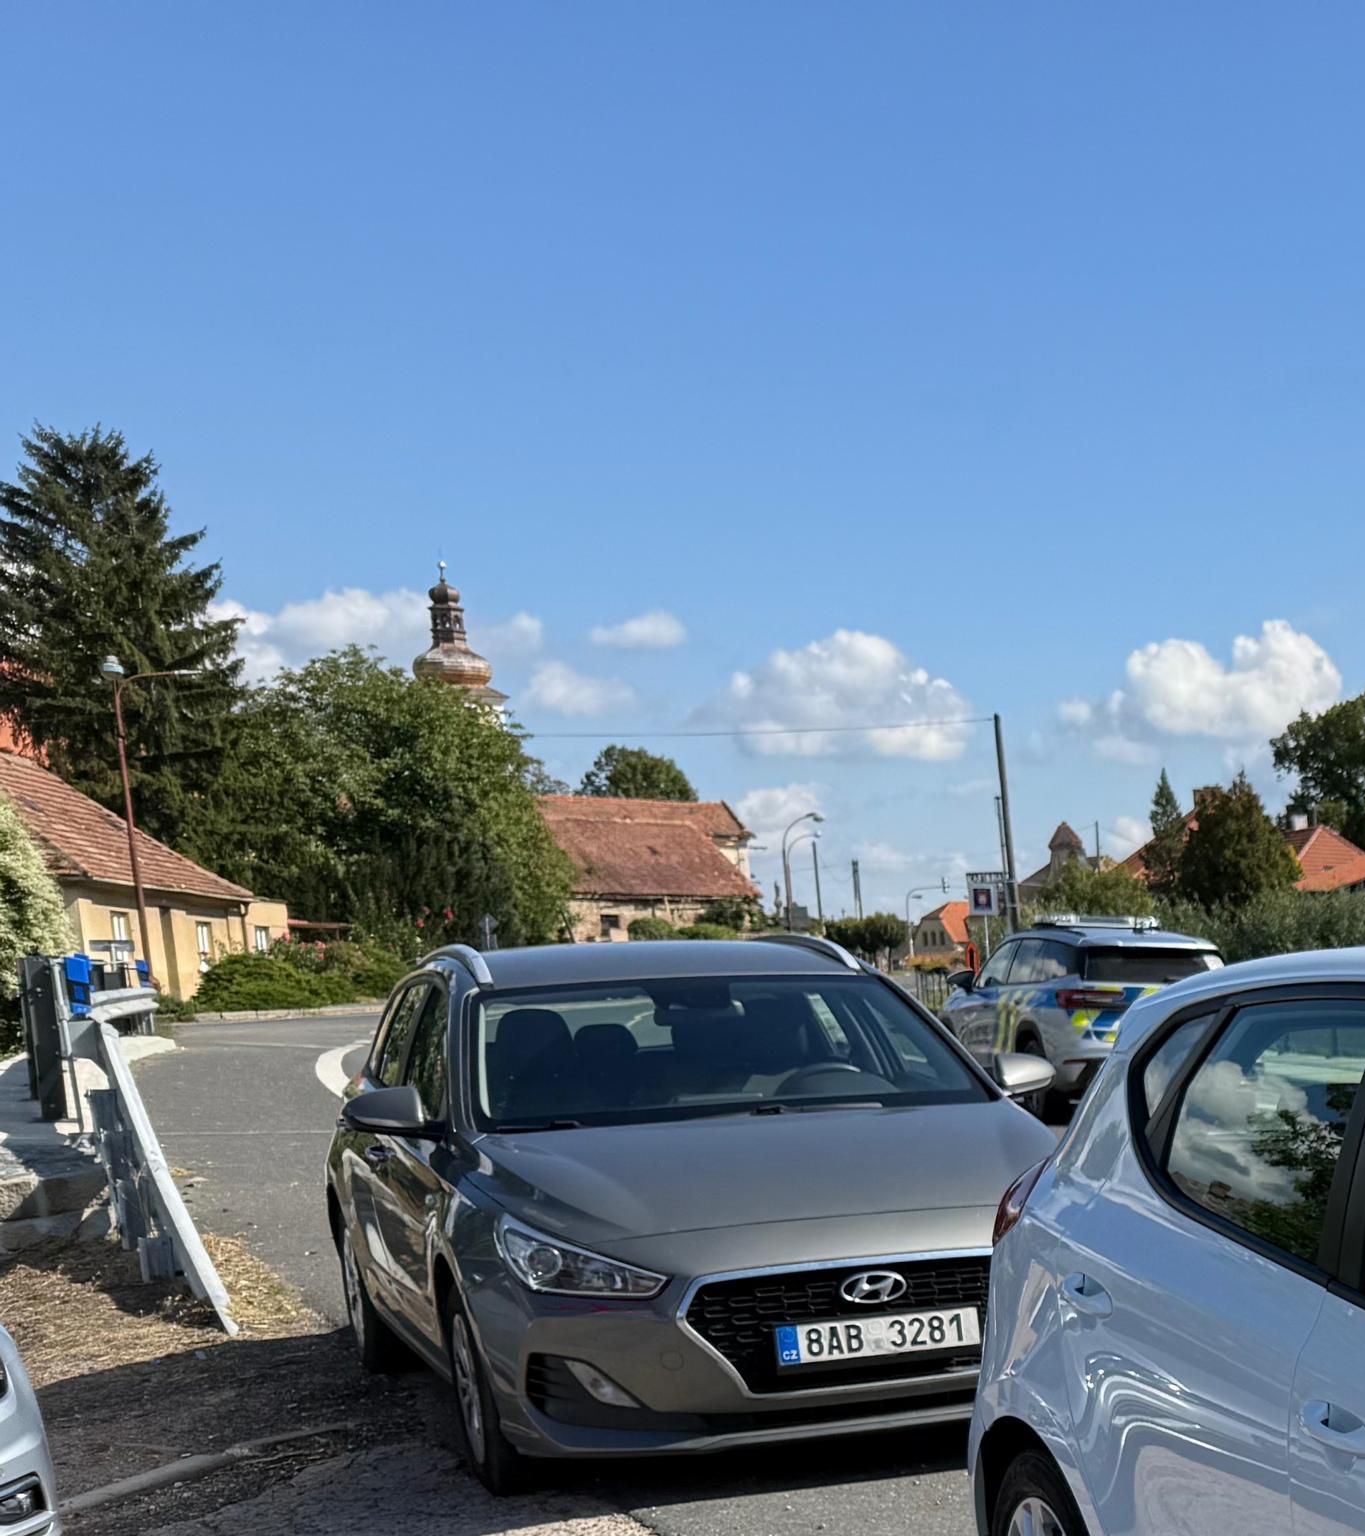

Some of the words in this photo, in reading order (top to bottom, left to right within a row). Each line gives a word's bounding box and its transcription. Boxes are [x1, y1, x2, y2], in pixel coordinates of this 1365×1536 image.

[805, 1325, 864, 1357] 8AB
[888, 1312, 964, 1348] 3281
[782, 1350, 799, 1361] CZ
